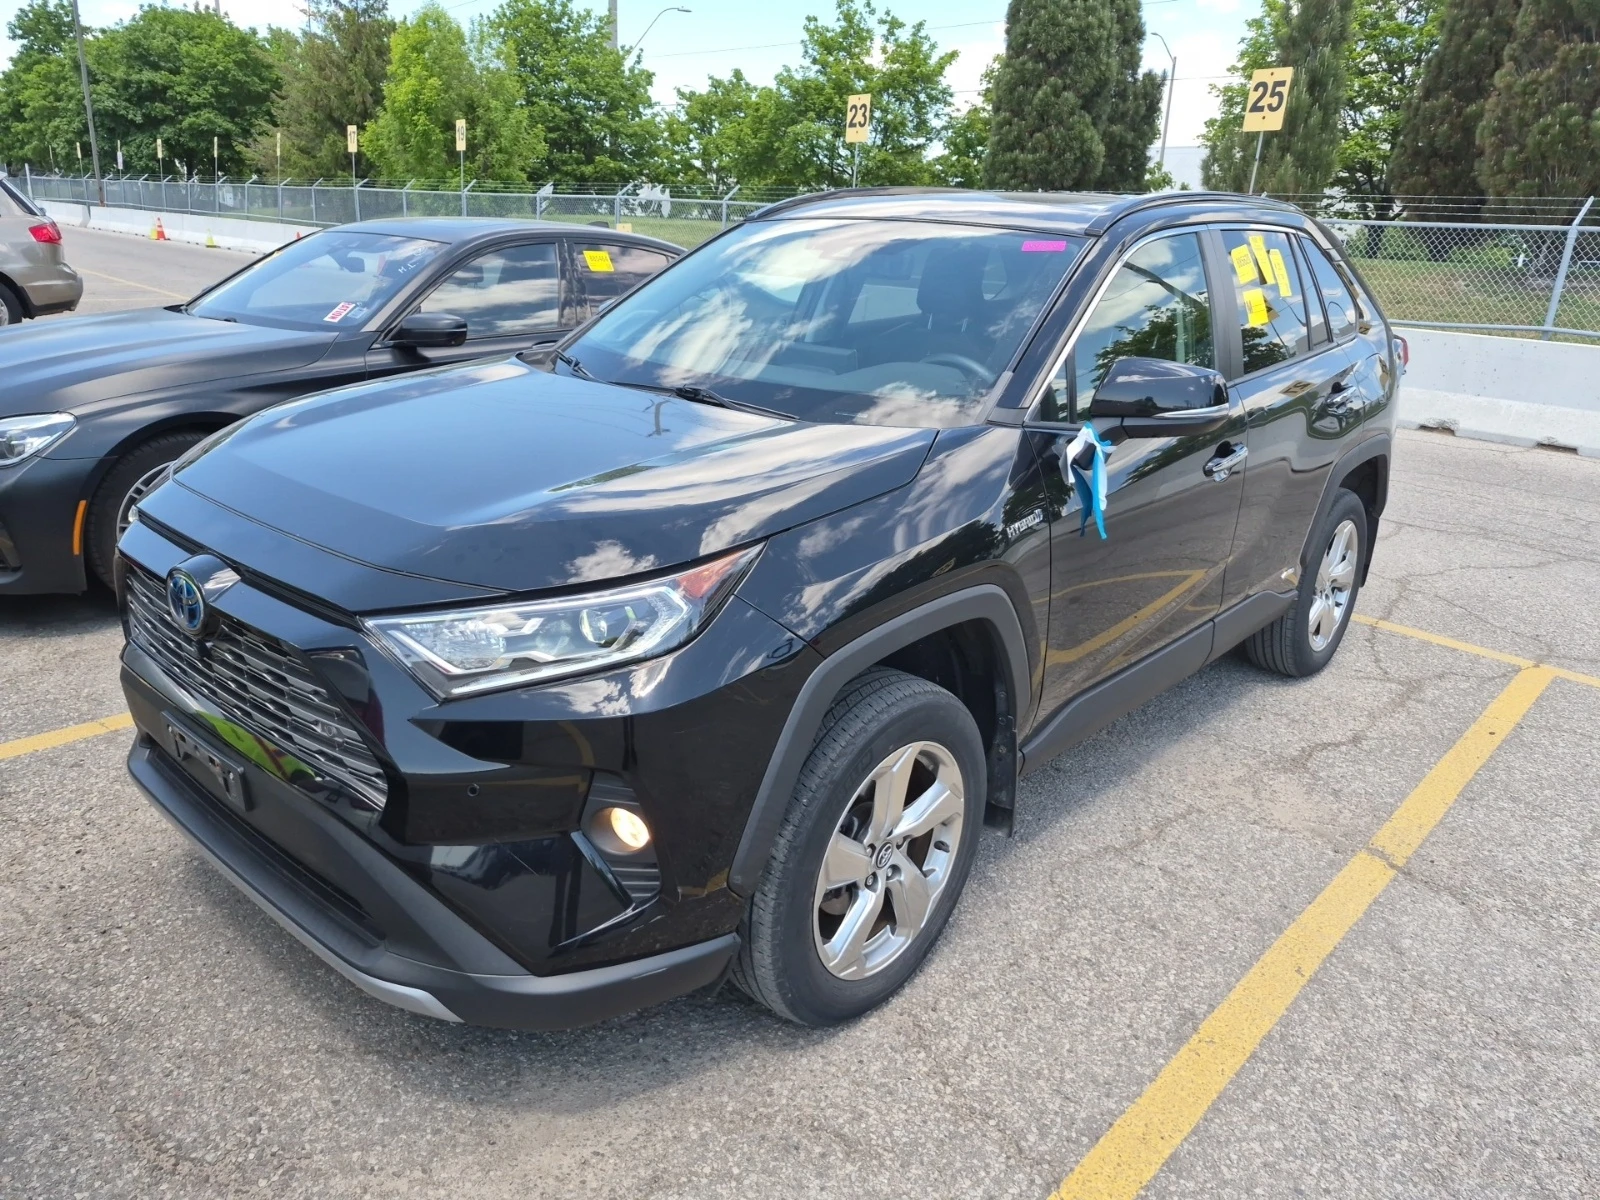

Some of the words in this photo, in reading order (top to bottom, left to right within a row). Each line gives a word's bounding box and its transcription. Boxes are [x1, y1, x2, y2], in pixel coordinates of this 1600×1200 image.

[1248, 80, 1287, 113] 25
[848, 103, 867, 128] 23
[348, 131, 356, 144] 17
[457, 126, 465, 141] 19
